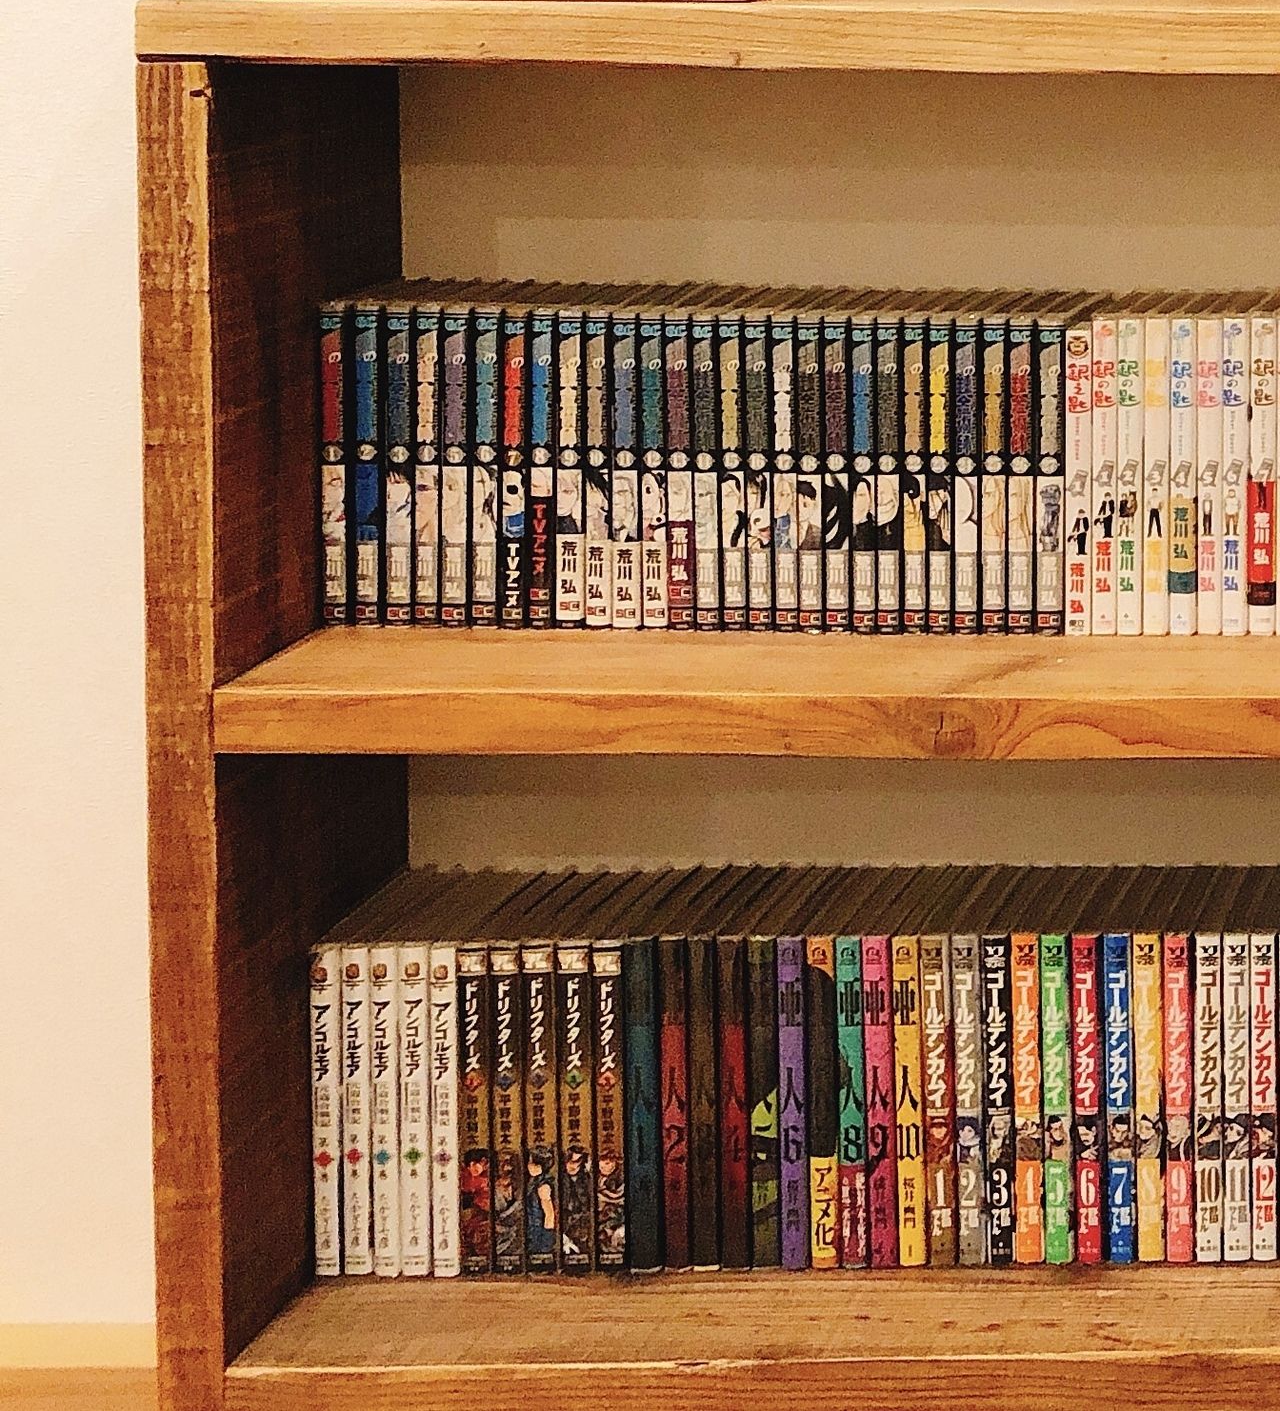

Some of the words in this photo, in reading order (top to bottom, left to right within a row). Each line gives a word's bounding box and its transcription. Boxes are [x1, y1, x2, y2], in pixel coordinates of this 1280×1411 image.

[1092, 358, 1117, 408] 銀の匙
[1117, 358, 1141, 408] 銀の匙
[504, 542, 521, 607] TVアニメ
[559, 540, 578, 595] 荒川弘
[587, 545, 605, 601] 荒川弘
[1095, 540, 1112, 593] 荒川弘
[1118, 540, 1135, 593] 荒川弘
[464, 978, 481, 1072] ドリフターズ
[497, 979, 514, 1072] ドリフターズ
[600, 978, 616, 1072] ドリフターズ
[923, 973, 945, 1108] ゴールデンカムイ
[984, 970, 1007, 1109] ゴールデンカムイ
[1106, 970, 1130, 1109] ゴールデンカムイ
[1252, 970, 1276, 1105] ゴールデンカムイ
[897, 1125, 920, 1161] 10
[814, 1166, 835, 1246] アニメ化
[934, 1169, 945, 1207] 1
[991, 1168, 1008, 1201] 3
[1112, 1167, 1127, 1202] 7
[1255, 1165, 1274, 1201] 12
